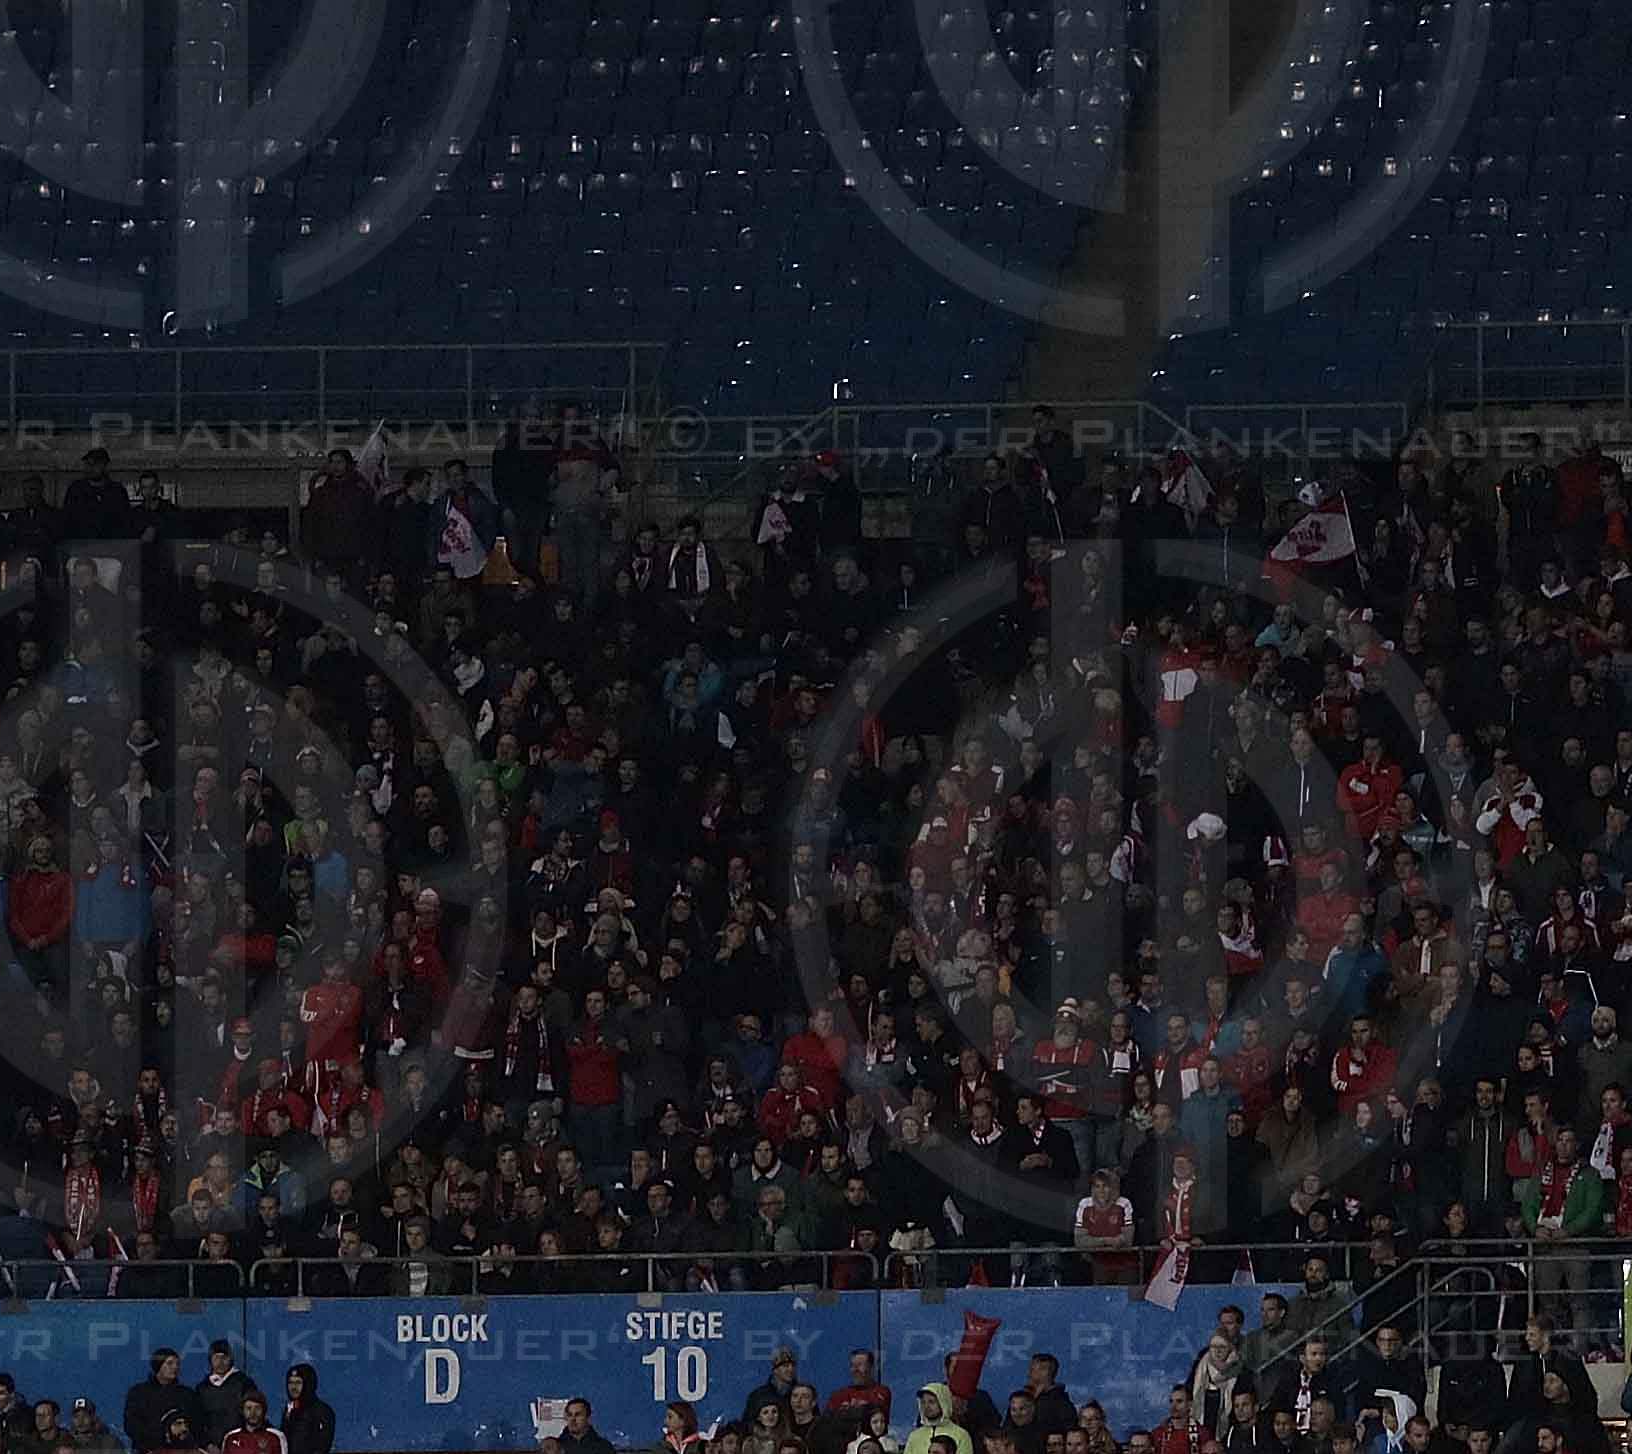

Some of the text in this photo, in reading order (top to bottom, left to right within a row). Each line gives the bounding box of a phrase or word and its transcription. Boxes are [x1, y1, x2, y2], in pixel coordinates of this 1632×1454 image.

[396, 1314, 489, 1344] BLOCK
[425, 1348, 462, 1404] D
[641, 1346, 709, 1402] 10
